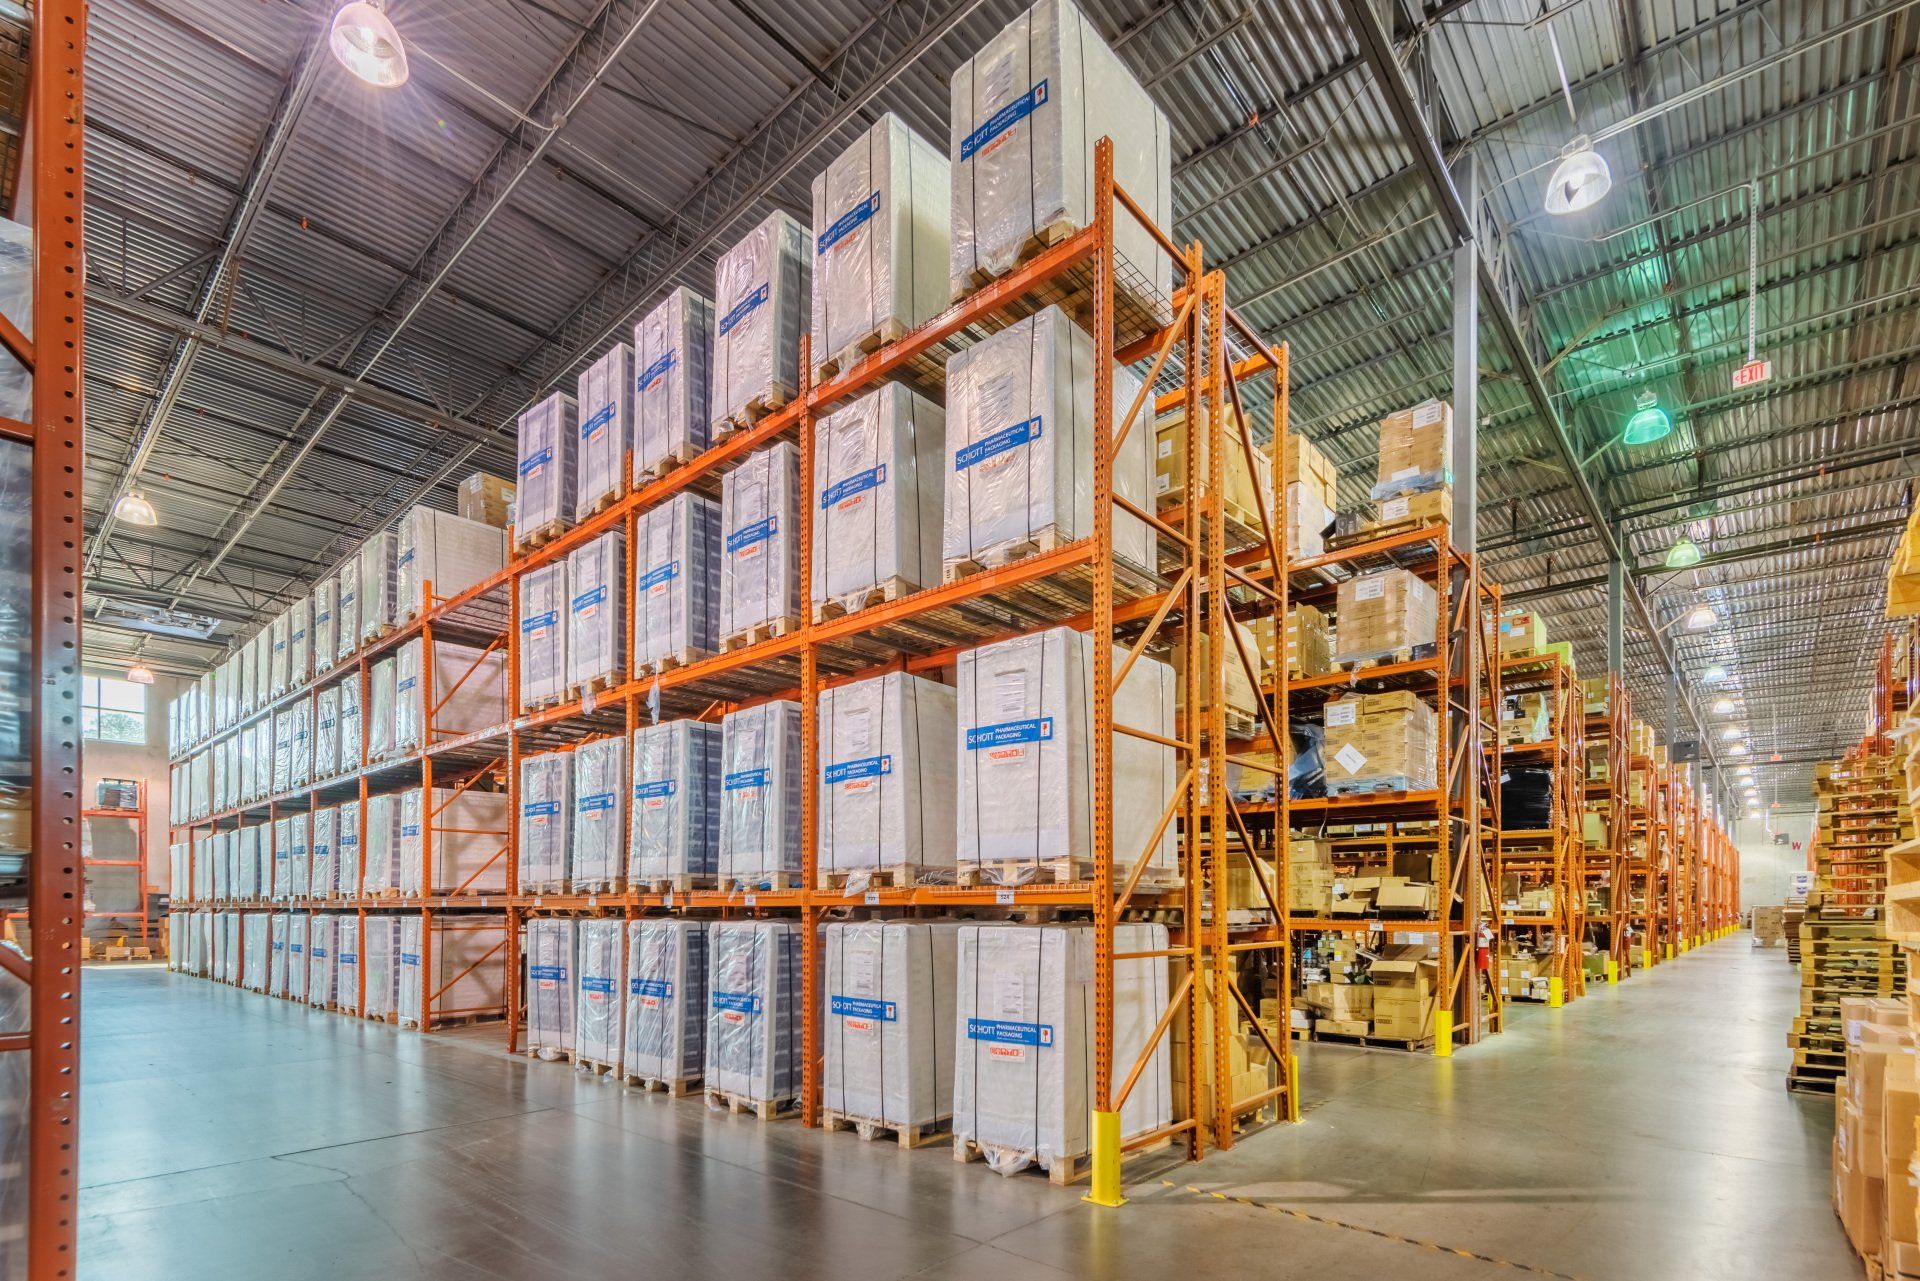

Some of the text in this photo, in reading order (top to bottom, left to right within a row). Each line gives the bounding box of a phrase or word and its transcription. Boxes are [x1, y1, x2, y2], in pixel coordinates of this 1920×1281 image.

[1740, 363, 1765, 384] EXIT
[984, 426, 1025, 447] PHARMACEUTICAL
[984, 439, 1011, 453] PACKAGING
[994, 723, 1037, 733] PHARMACEUTICAL
[968, 732, 994, 744] SCHOTT
[995, 732, 1022, 740] PACKAGING
[1791, 841, 1802, 850] W
[969, 1024, 995, 1035] SCHOTT
[996, 1024, 1037, 1033] PHARMACEUTICAL
[996, 1031, 1023, 1039] PACKAGING
